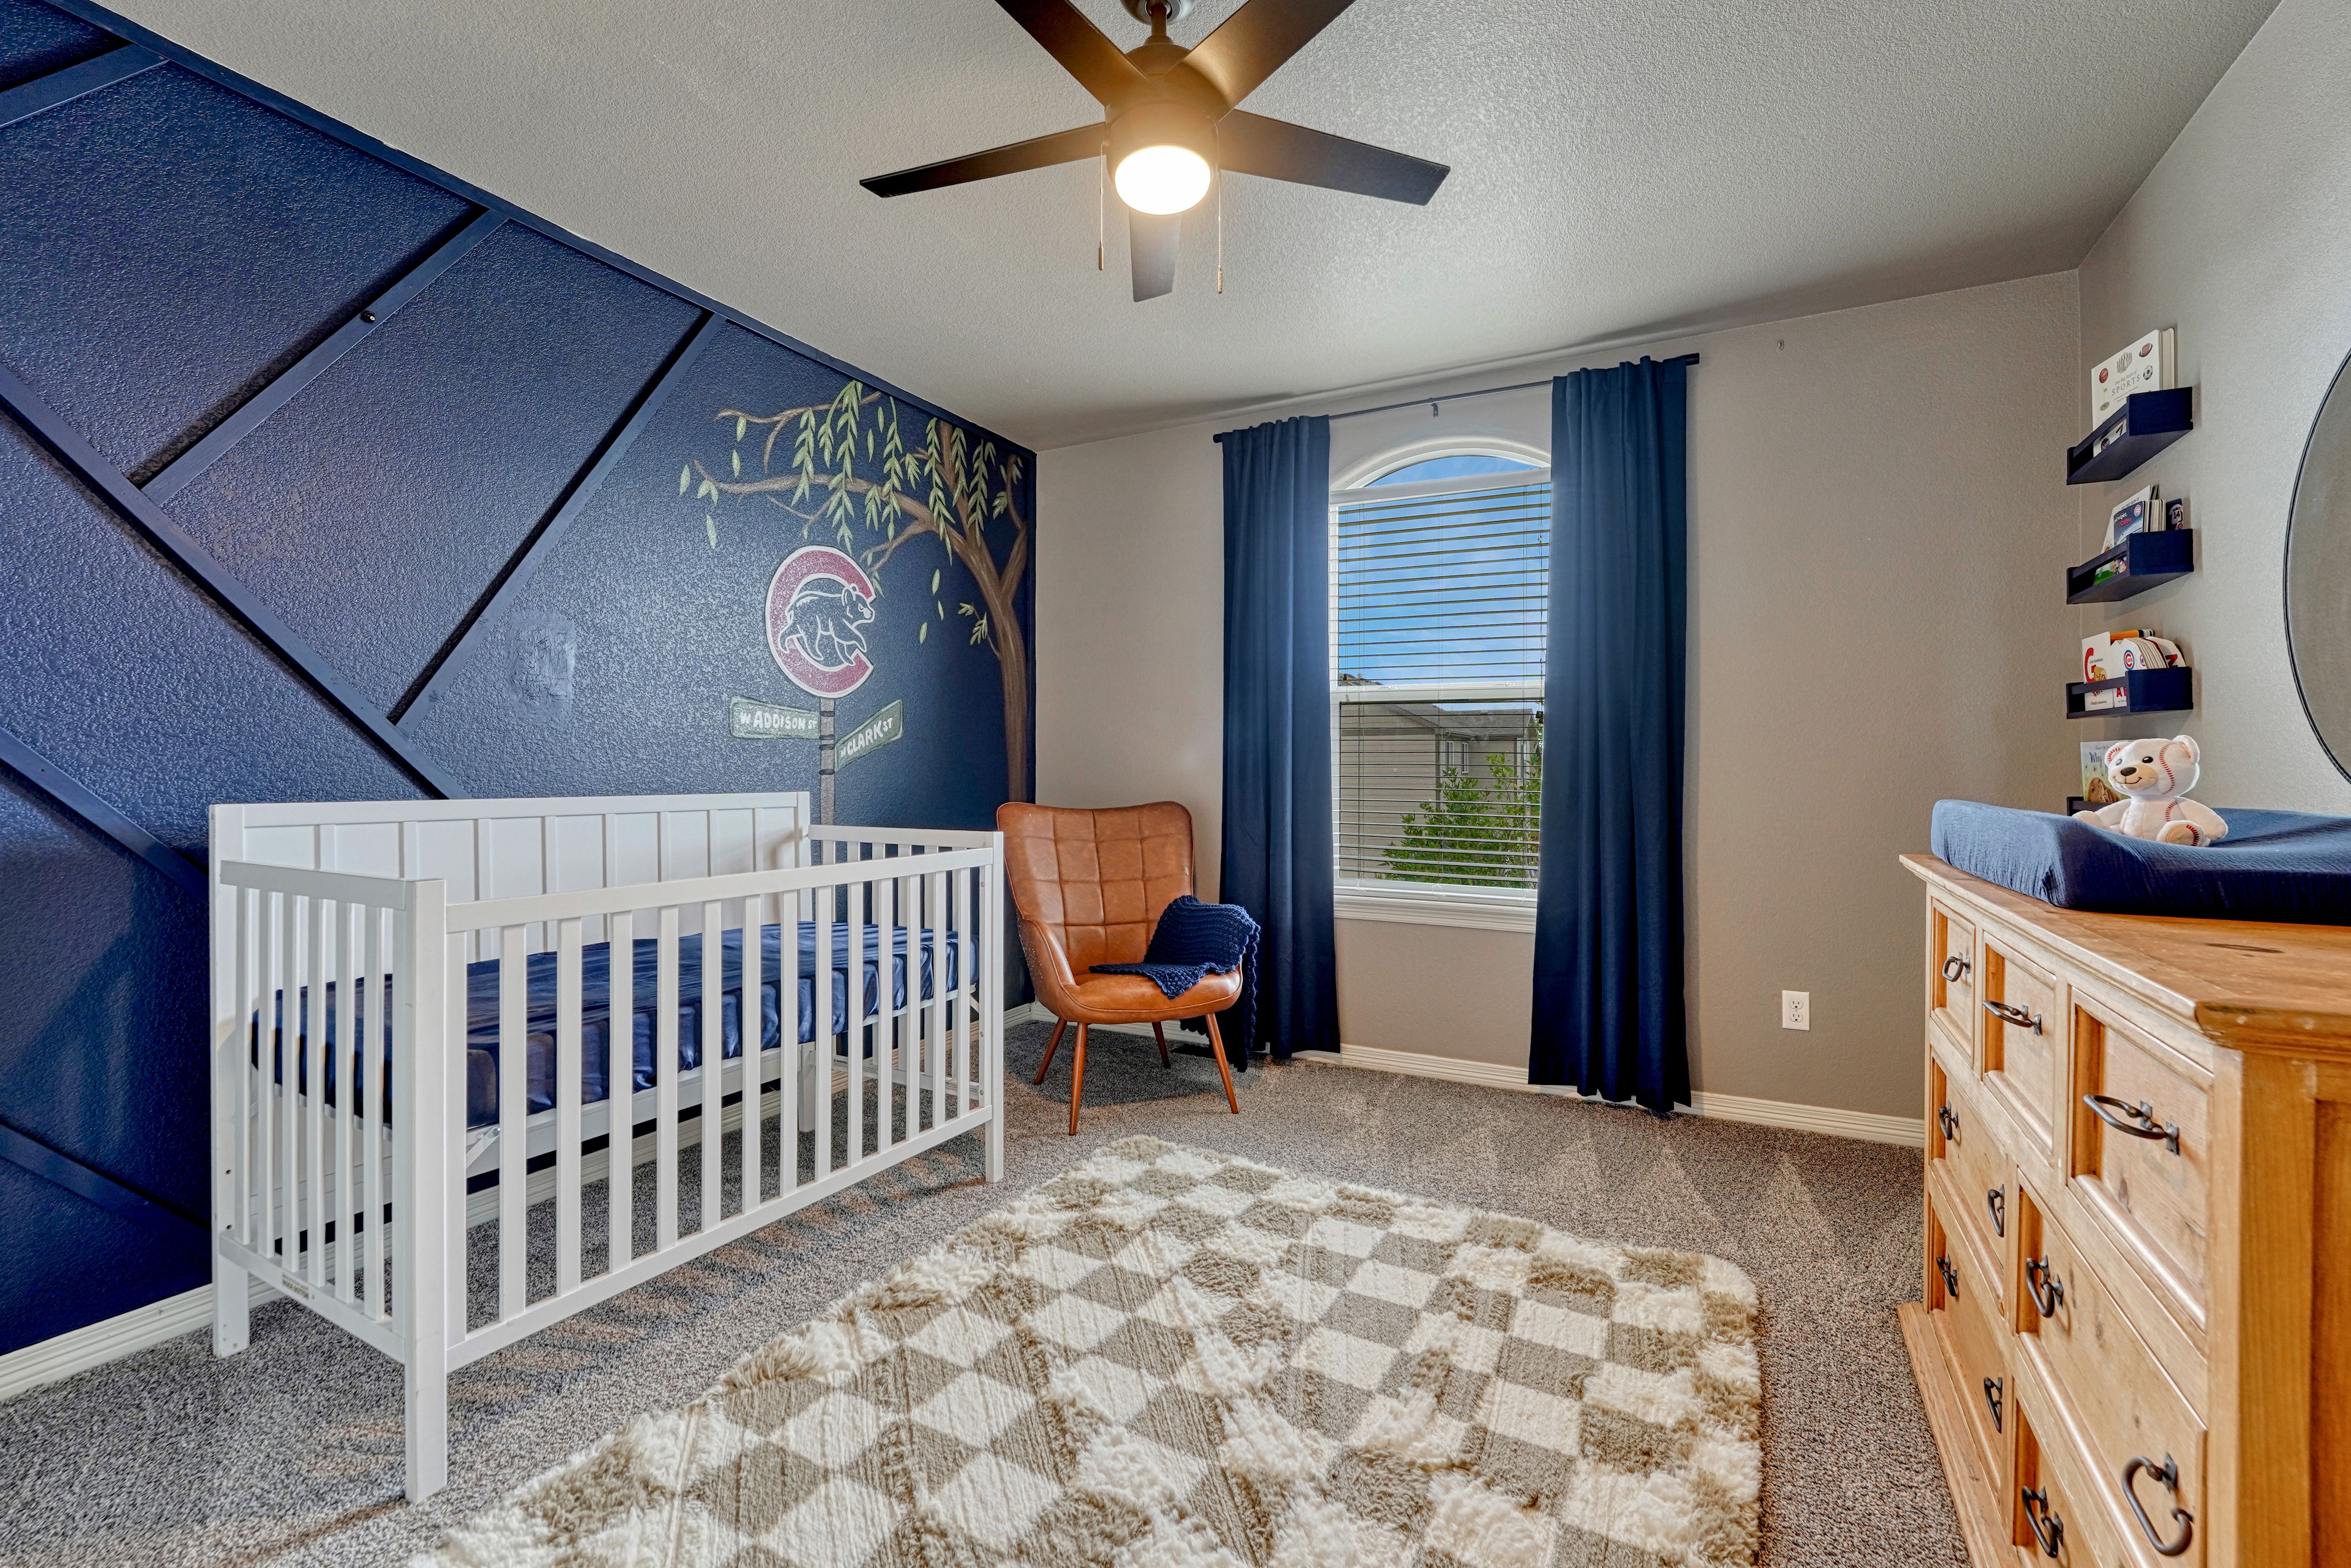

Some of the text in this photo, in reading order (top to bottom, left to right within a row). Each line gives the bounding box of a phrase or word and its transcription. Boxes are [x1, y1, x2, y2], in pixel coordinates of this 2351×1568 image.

[2112, 374, 2140, 395] SPORTS
[2173, 511, 2180, 519] 14
[740, 711, 817, 730] W ADDISON ST
[847, 720, 884, 756] CLARK
[883, 718, 893, 732] ST
[2089, 752, 2102, 768] Why
